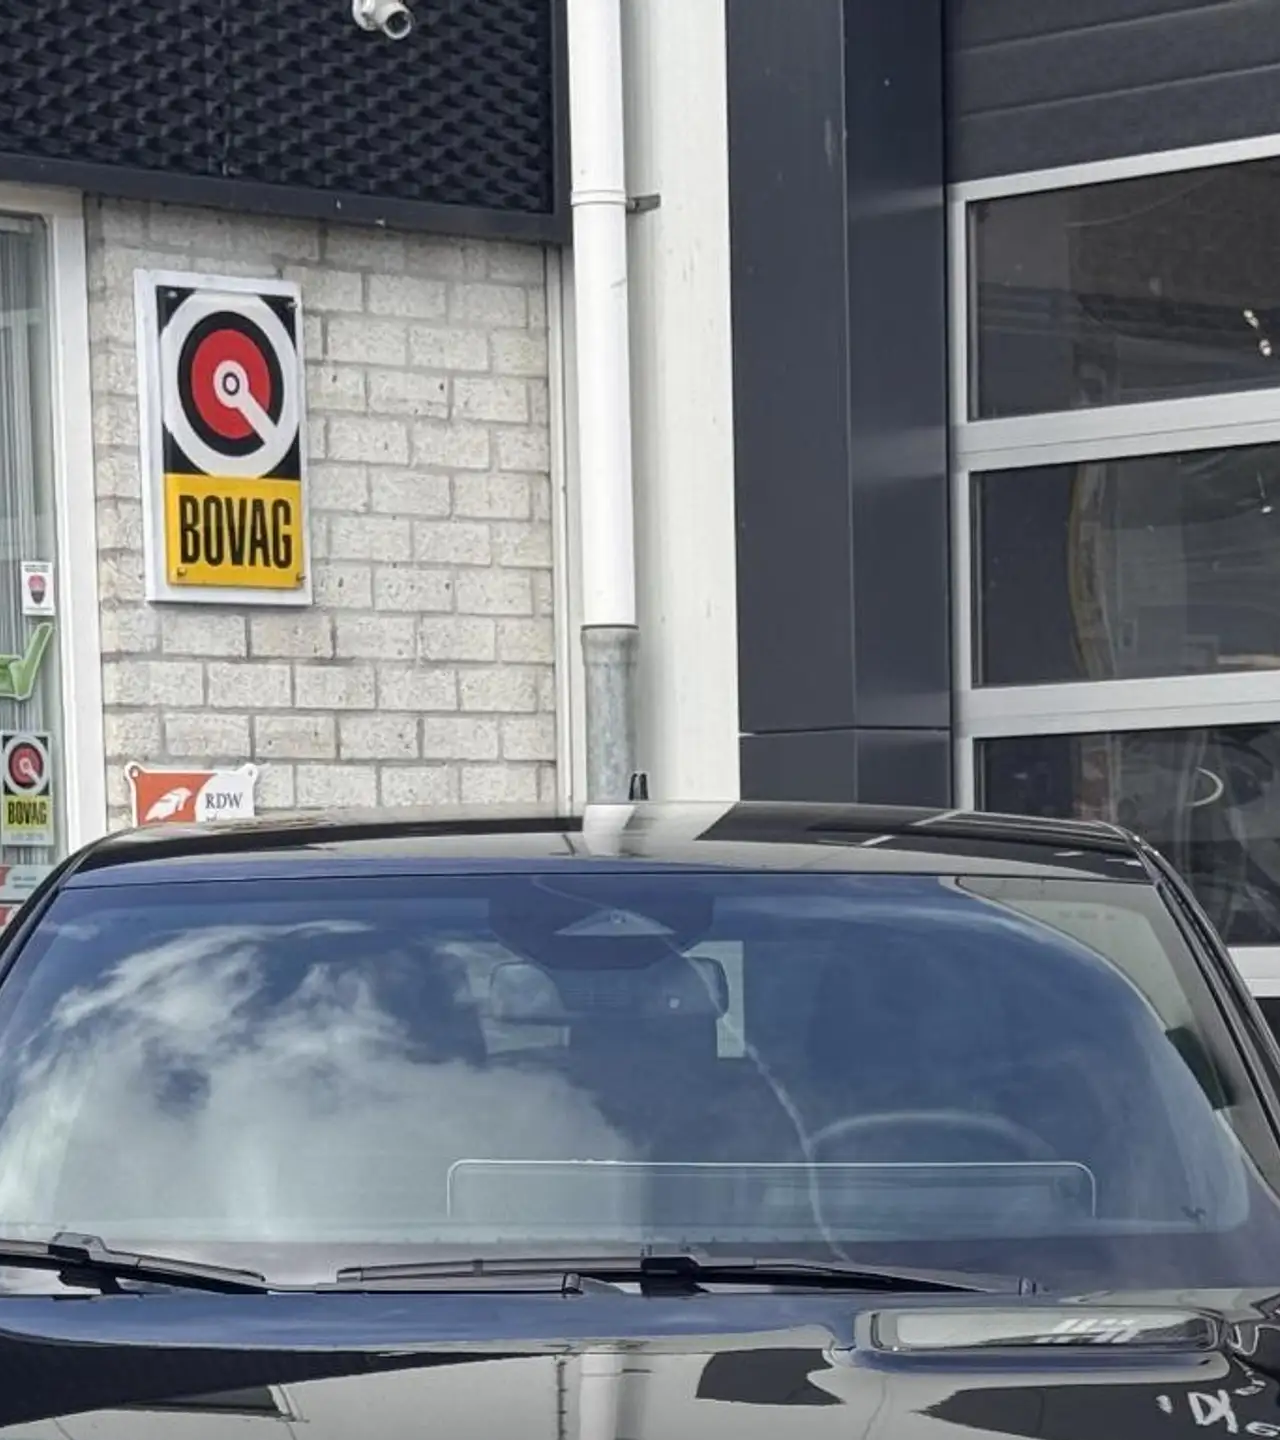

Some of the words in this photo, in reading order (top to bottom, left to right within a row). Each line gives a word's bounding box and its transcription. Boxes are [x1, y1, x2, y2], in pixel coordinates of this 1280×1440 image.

[179, 494, 293, 569] BOVAG
[205, 792, 243, 809] RDW
[7, 801, 48, 825] BOVAG
